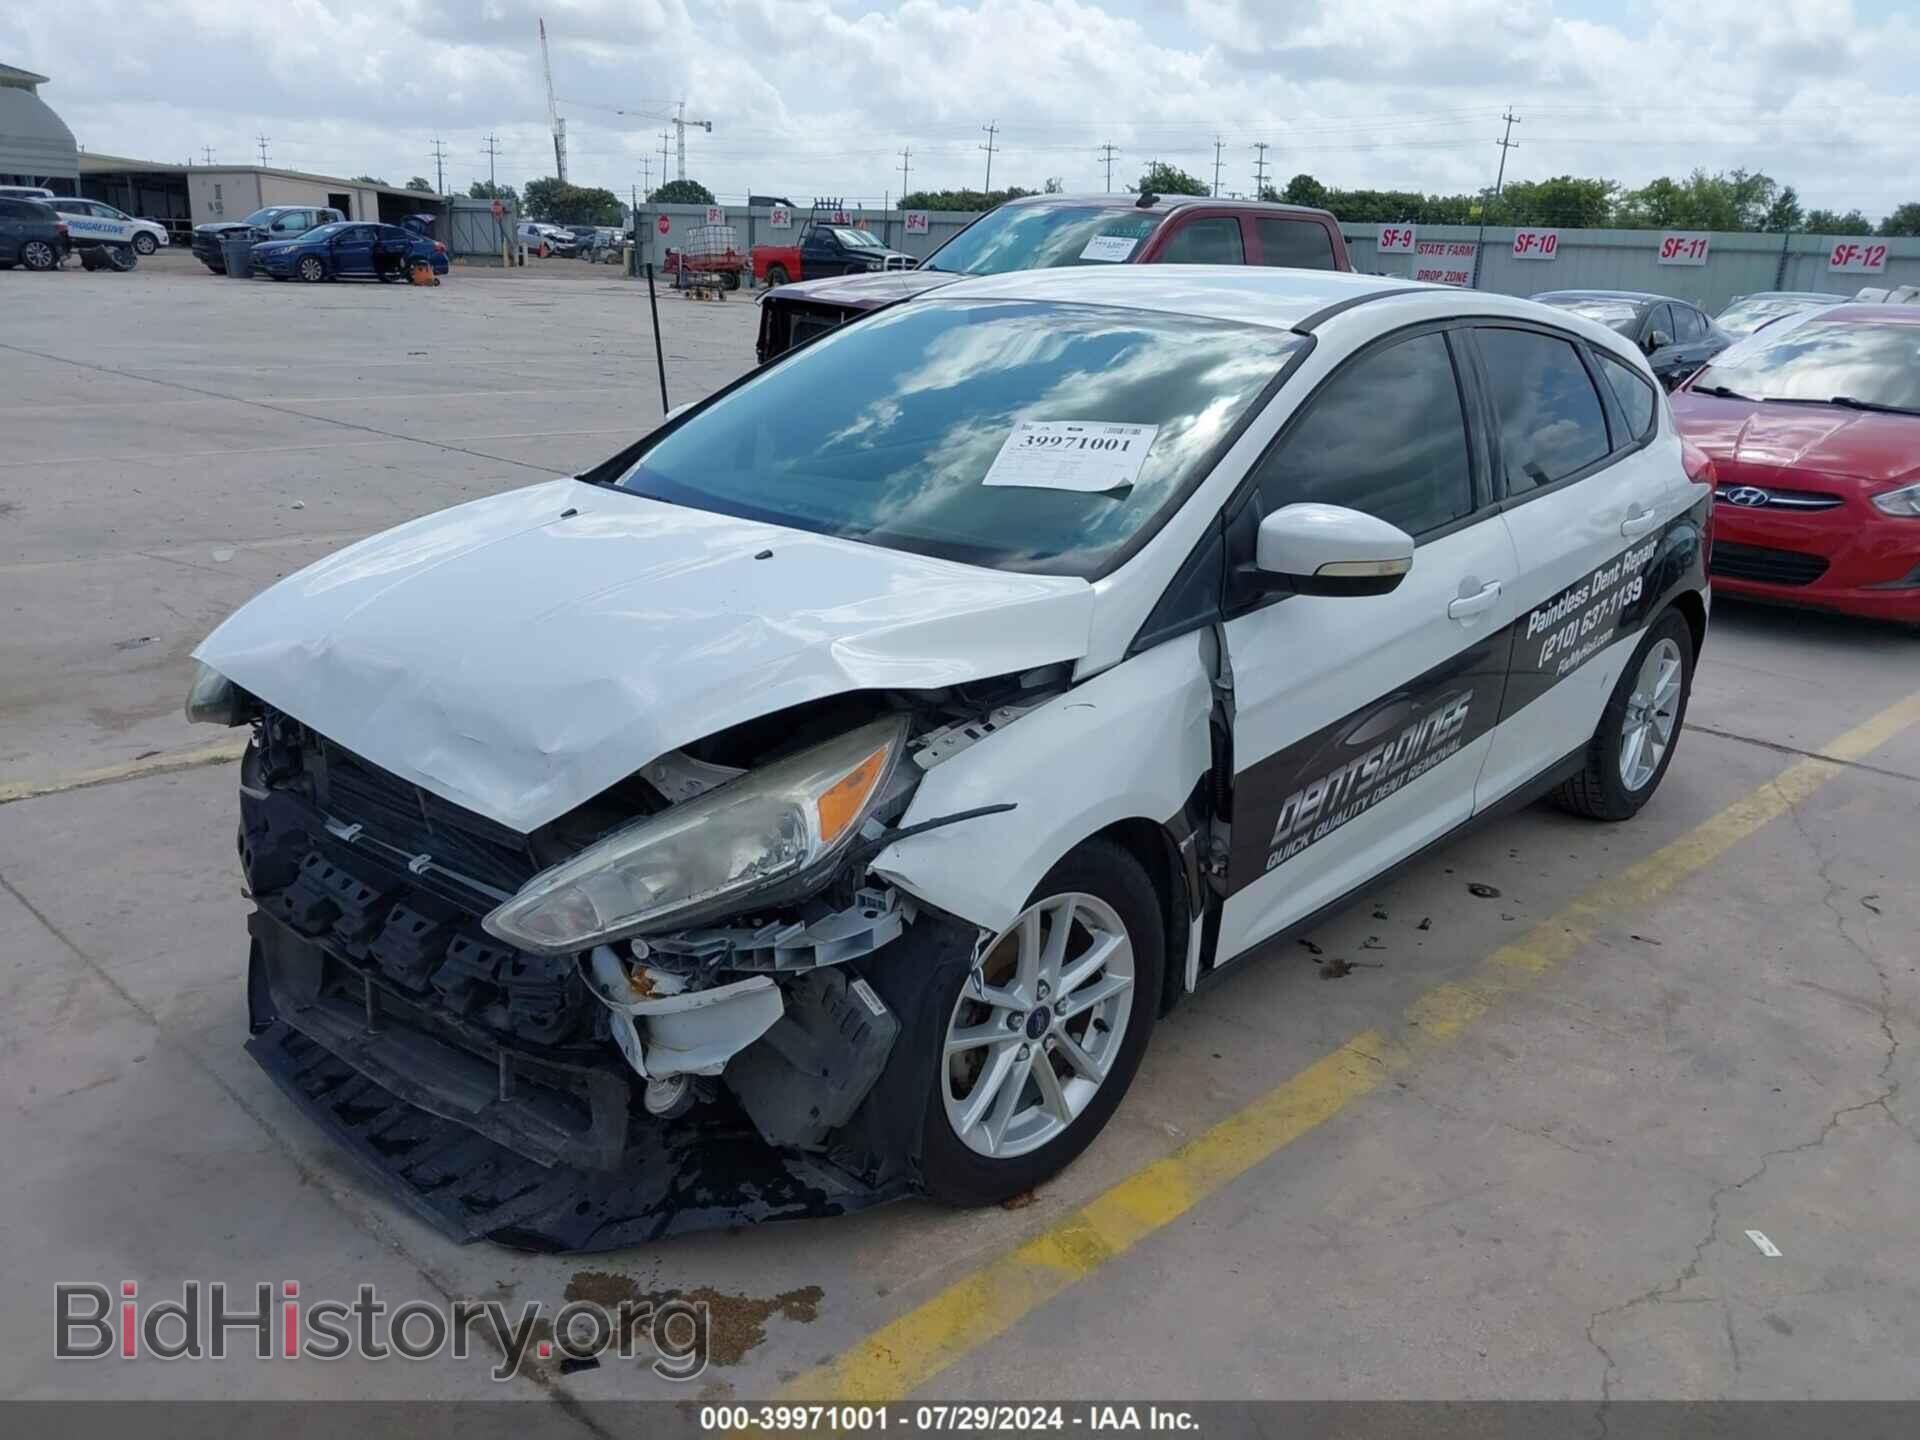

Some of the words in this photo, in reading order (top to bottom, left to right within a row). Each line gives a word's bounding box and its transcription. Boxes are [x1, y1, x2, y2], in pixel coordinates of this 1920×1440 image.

[67, 219, 125, 233] PROGRESSIVE
[906, 214, 926, 229] SF-4
[1381, 228, 1412, 248] SF-9
[1514, 233, 1557, 254] SF-10
[1661, 237, 1707, 259] SF-11
[1417, 243, 1445, 256] STATE
[1447, 244, 1475, 257] FARM
[1831, 244, 1887, 267] SF-12
[1416, 269, 1442, 281] DROP
[1443, 271, 1470, 283] ZONE
[1018, 434, 1132, 452] 39971001
[1526, 584, 1590, 640] Paintless
[1591, 562, 1622, 598] Dent
[1622, 536, 1657, 576] Repair
[1538, 618, 1580, 669] (210)
[1580, 576, 1643, 636] 637-1139
[1266, 833, 1314, 870] QUICK
[1313, 794, 1371, 840] QUALITY
[1373, 774, 1406, 804] DENT
[1407, 737, 1463, 782] REMOVAL
